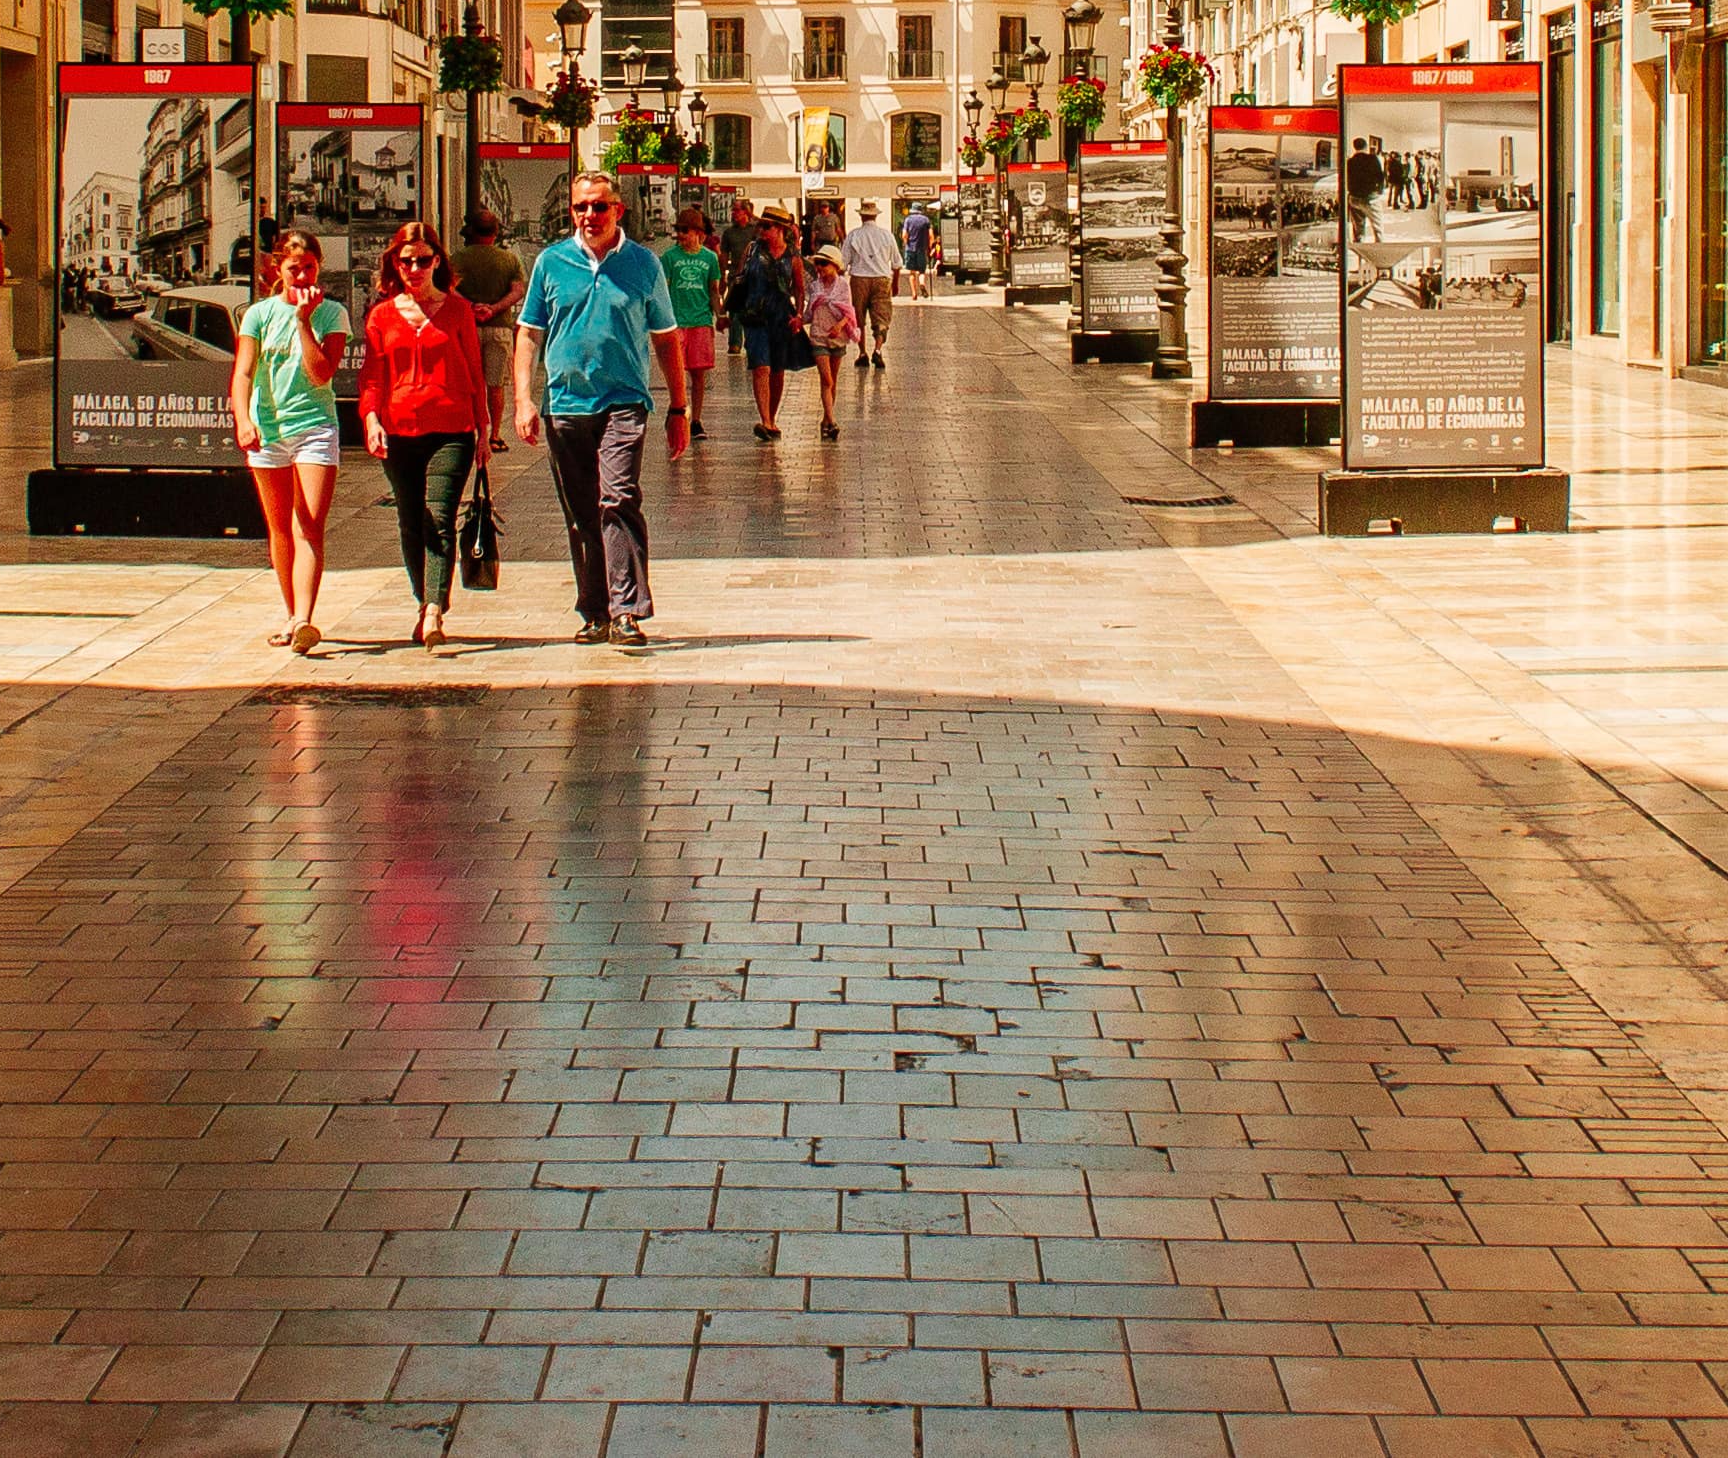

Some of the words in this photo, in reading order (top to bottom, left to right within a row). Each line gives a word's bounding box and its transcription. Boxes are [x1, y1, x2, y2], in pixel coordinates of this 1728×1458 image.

[146, 43, 181, 55] COS
[1284, 346, 1311, 360] AÑOS
[1313, 347, 1325, 359] DE
[1269, 360, 1281, 372] DE
[73, 393, 135, 410] MÁLAGA.
[137, 395, 154, 411] 50
[158, 393, 194, 411] AÑOS
[198, 396, 214, 411] DE
[1361, 396, 1425, 414] MÁLAGA.
[1426, 397, 1444, 413] 50
[1447, 395, 1484, 413] AÑOS
[1487, 396, 1504, 412] DE
[1507, 396, 1525, 412] LA
[73, 411, 135, 427] FACULTAD
[138, 412, 153, 427] DE
[156, 410, 234, 428] ECONÓMICAS
[1361, 414, 1425, 430] FACULTAD
[1427, 414, 1443, 429] DE
[1445, 412, 1526, 430] ECONÓMICAS
